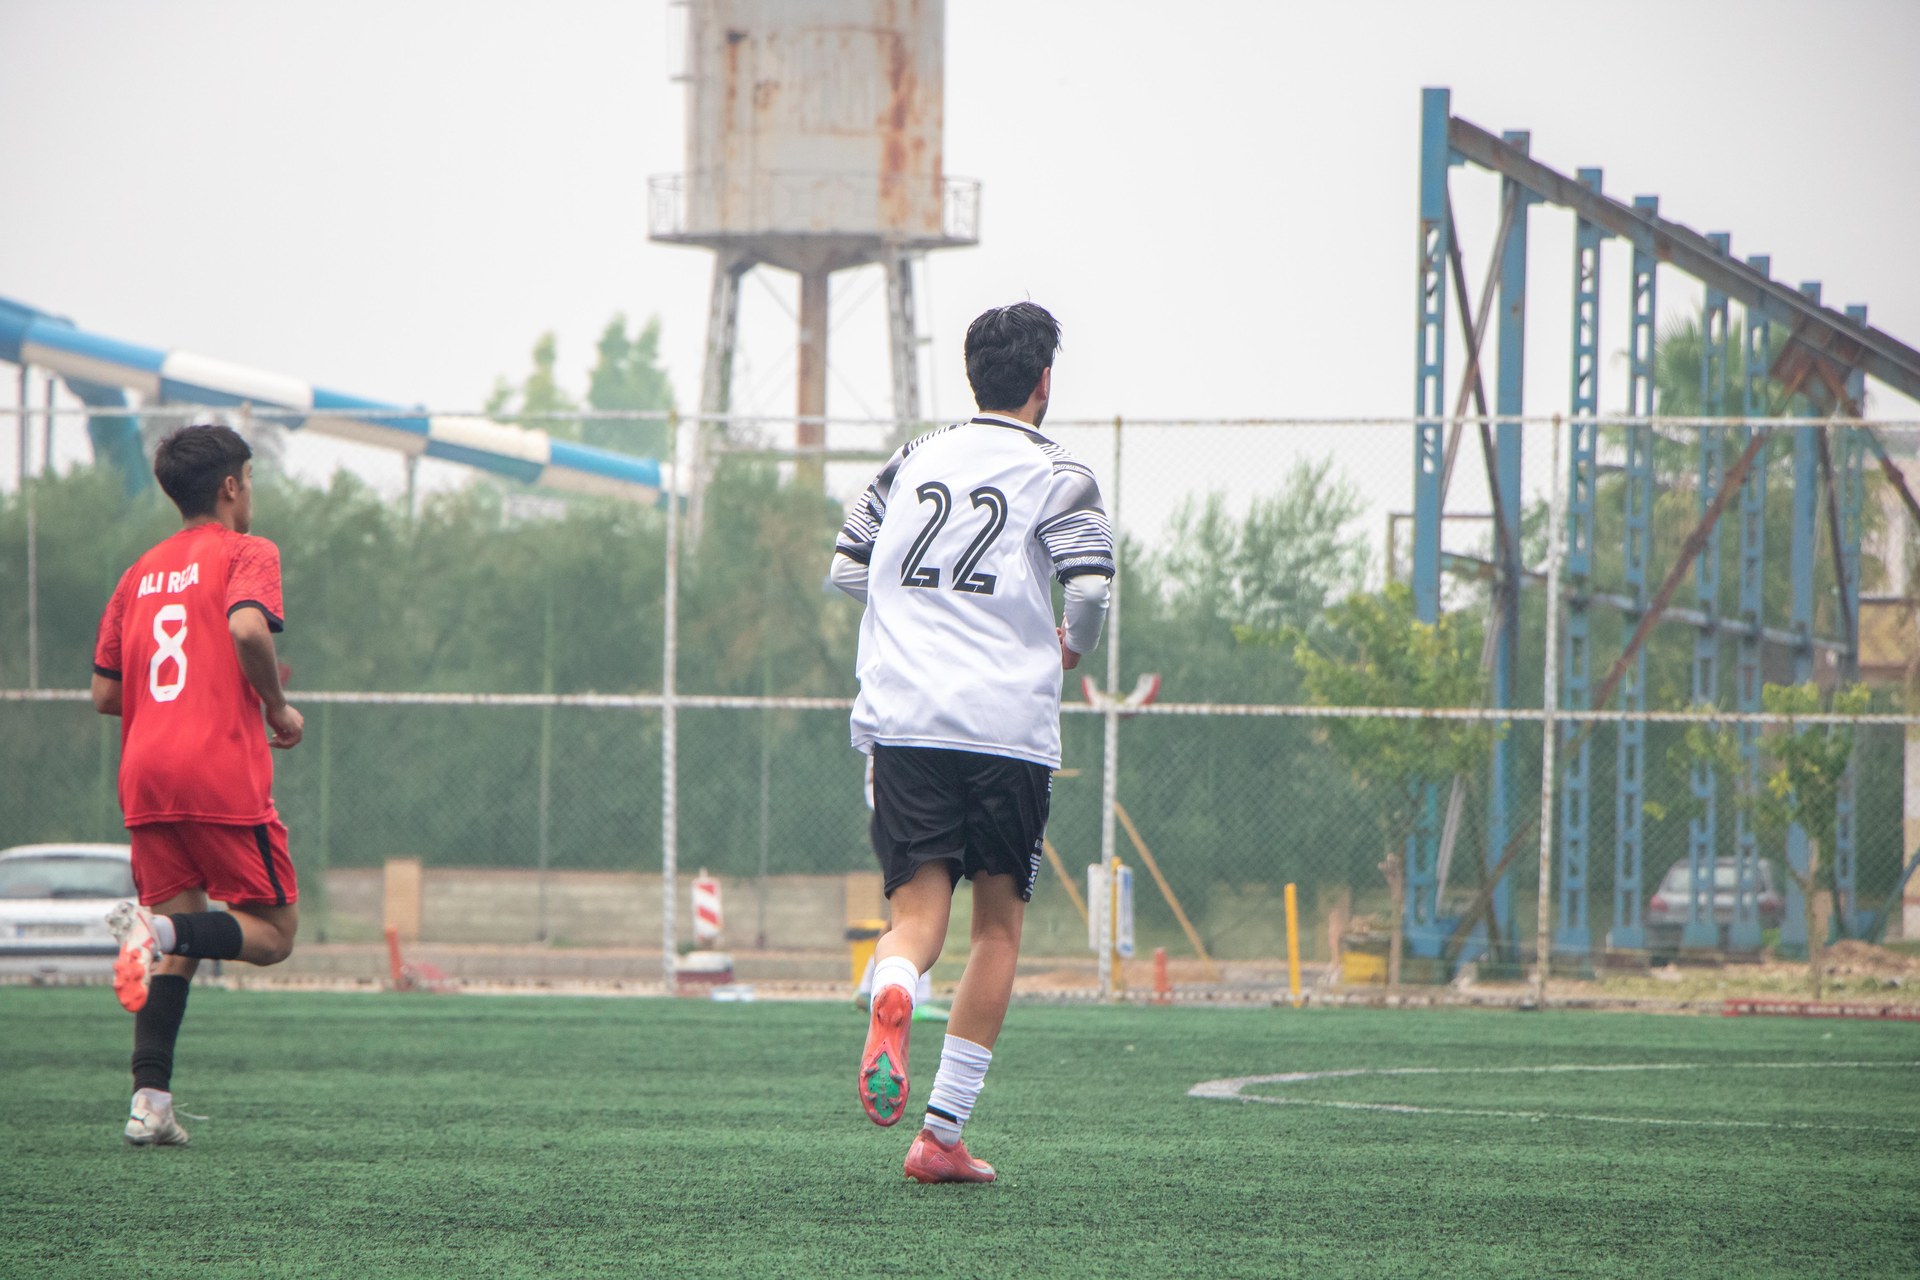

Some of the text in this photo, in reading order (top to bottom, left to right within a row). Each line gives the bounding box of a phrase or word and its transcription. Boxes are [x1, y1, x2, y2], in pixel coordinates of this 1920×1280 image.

[137, 571, 164, 598] ALI
[901, 481, 1008, 595] 22
[150, 604, 188, 702] 8
